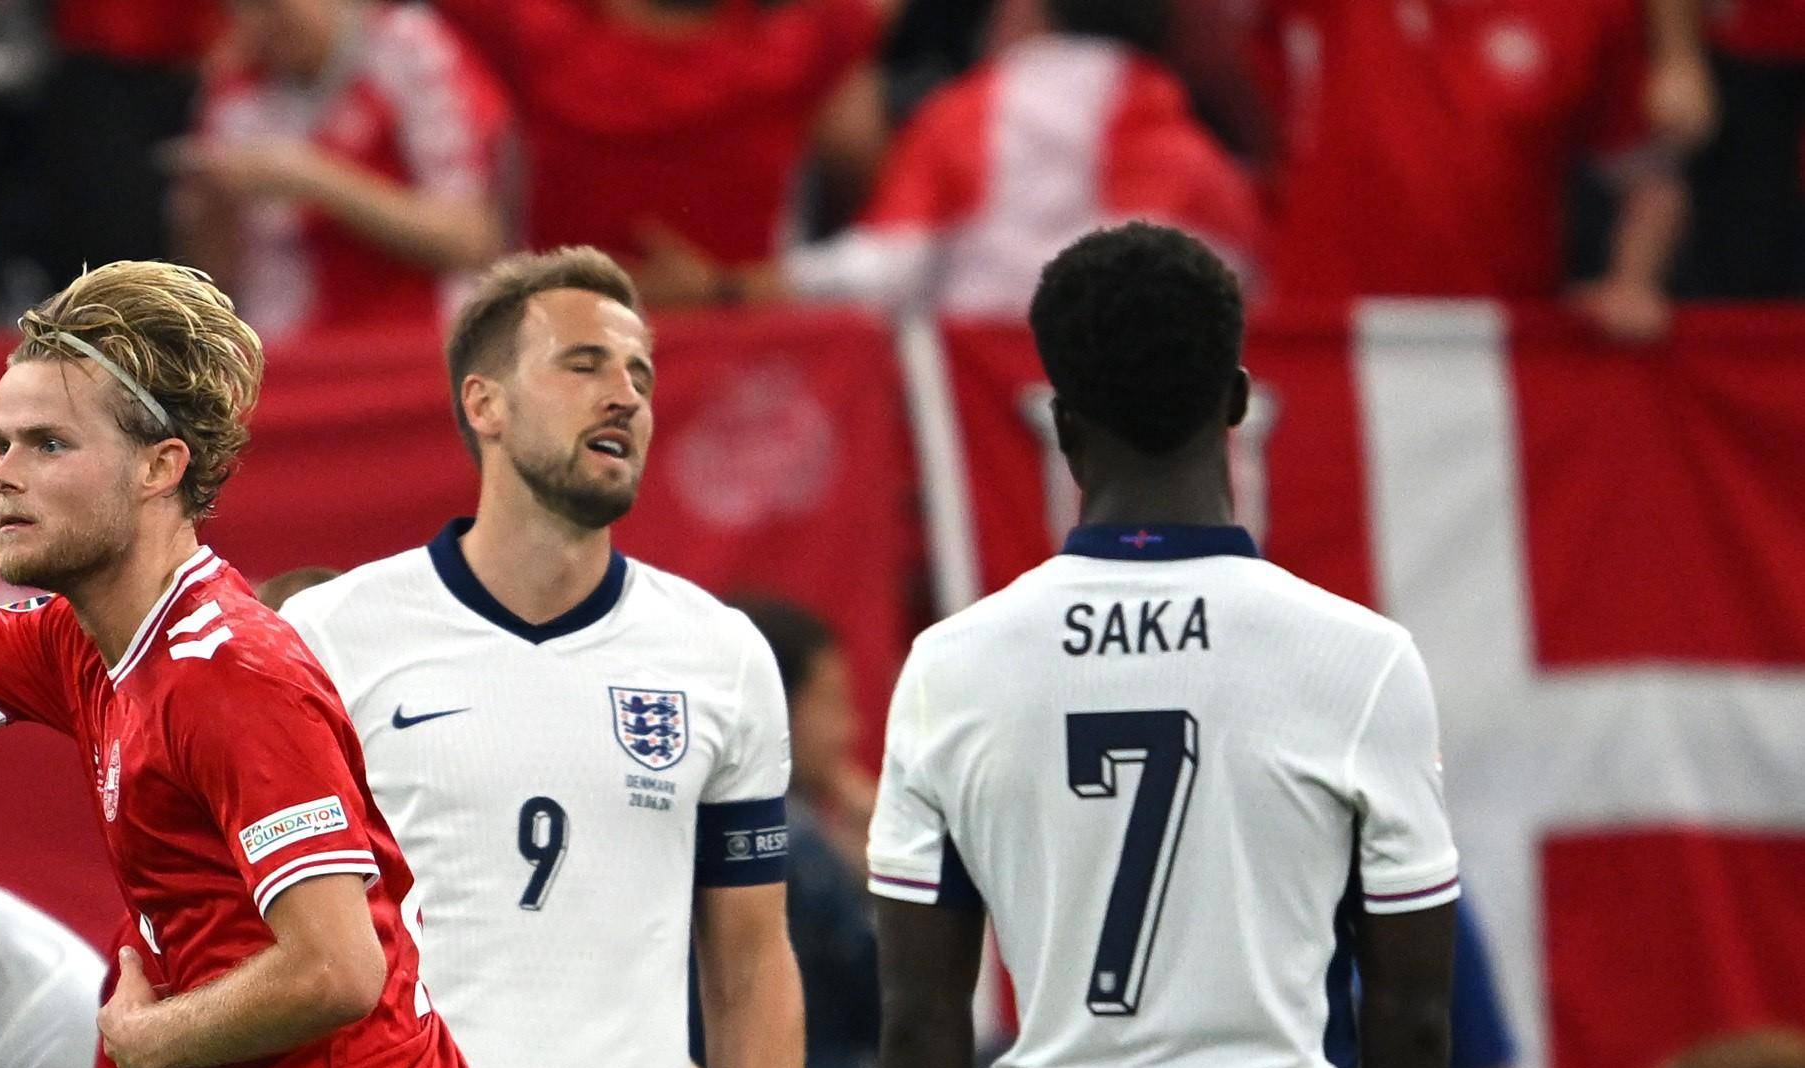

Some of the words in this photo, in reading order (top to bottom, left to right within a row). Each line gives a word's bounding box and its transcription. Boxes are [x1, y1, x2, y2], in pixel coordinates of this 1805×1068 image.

[1062, 597, 1210, 656] SAKA
[244, 806, 343, 852] FOUNDATION
[517, 796, 571, 912] 9
[1066, 710, 1199, 1017] 7
